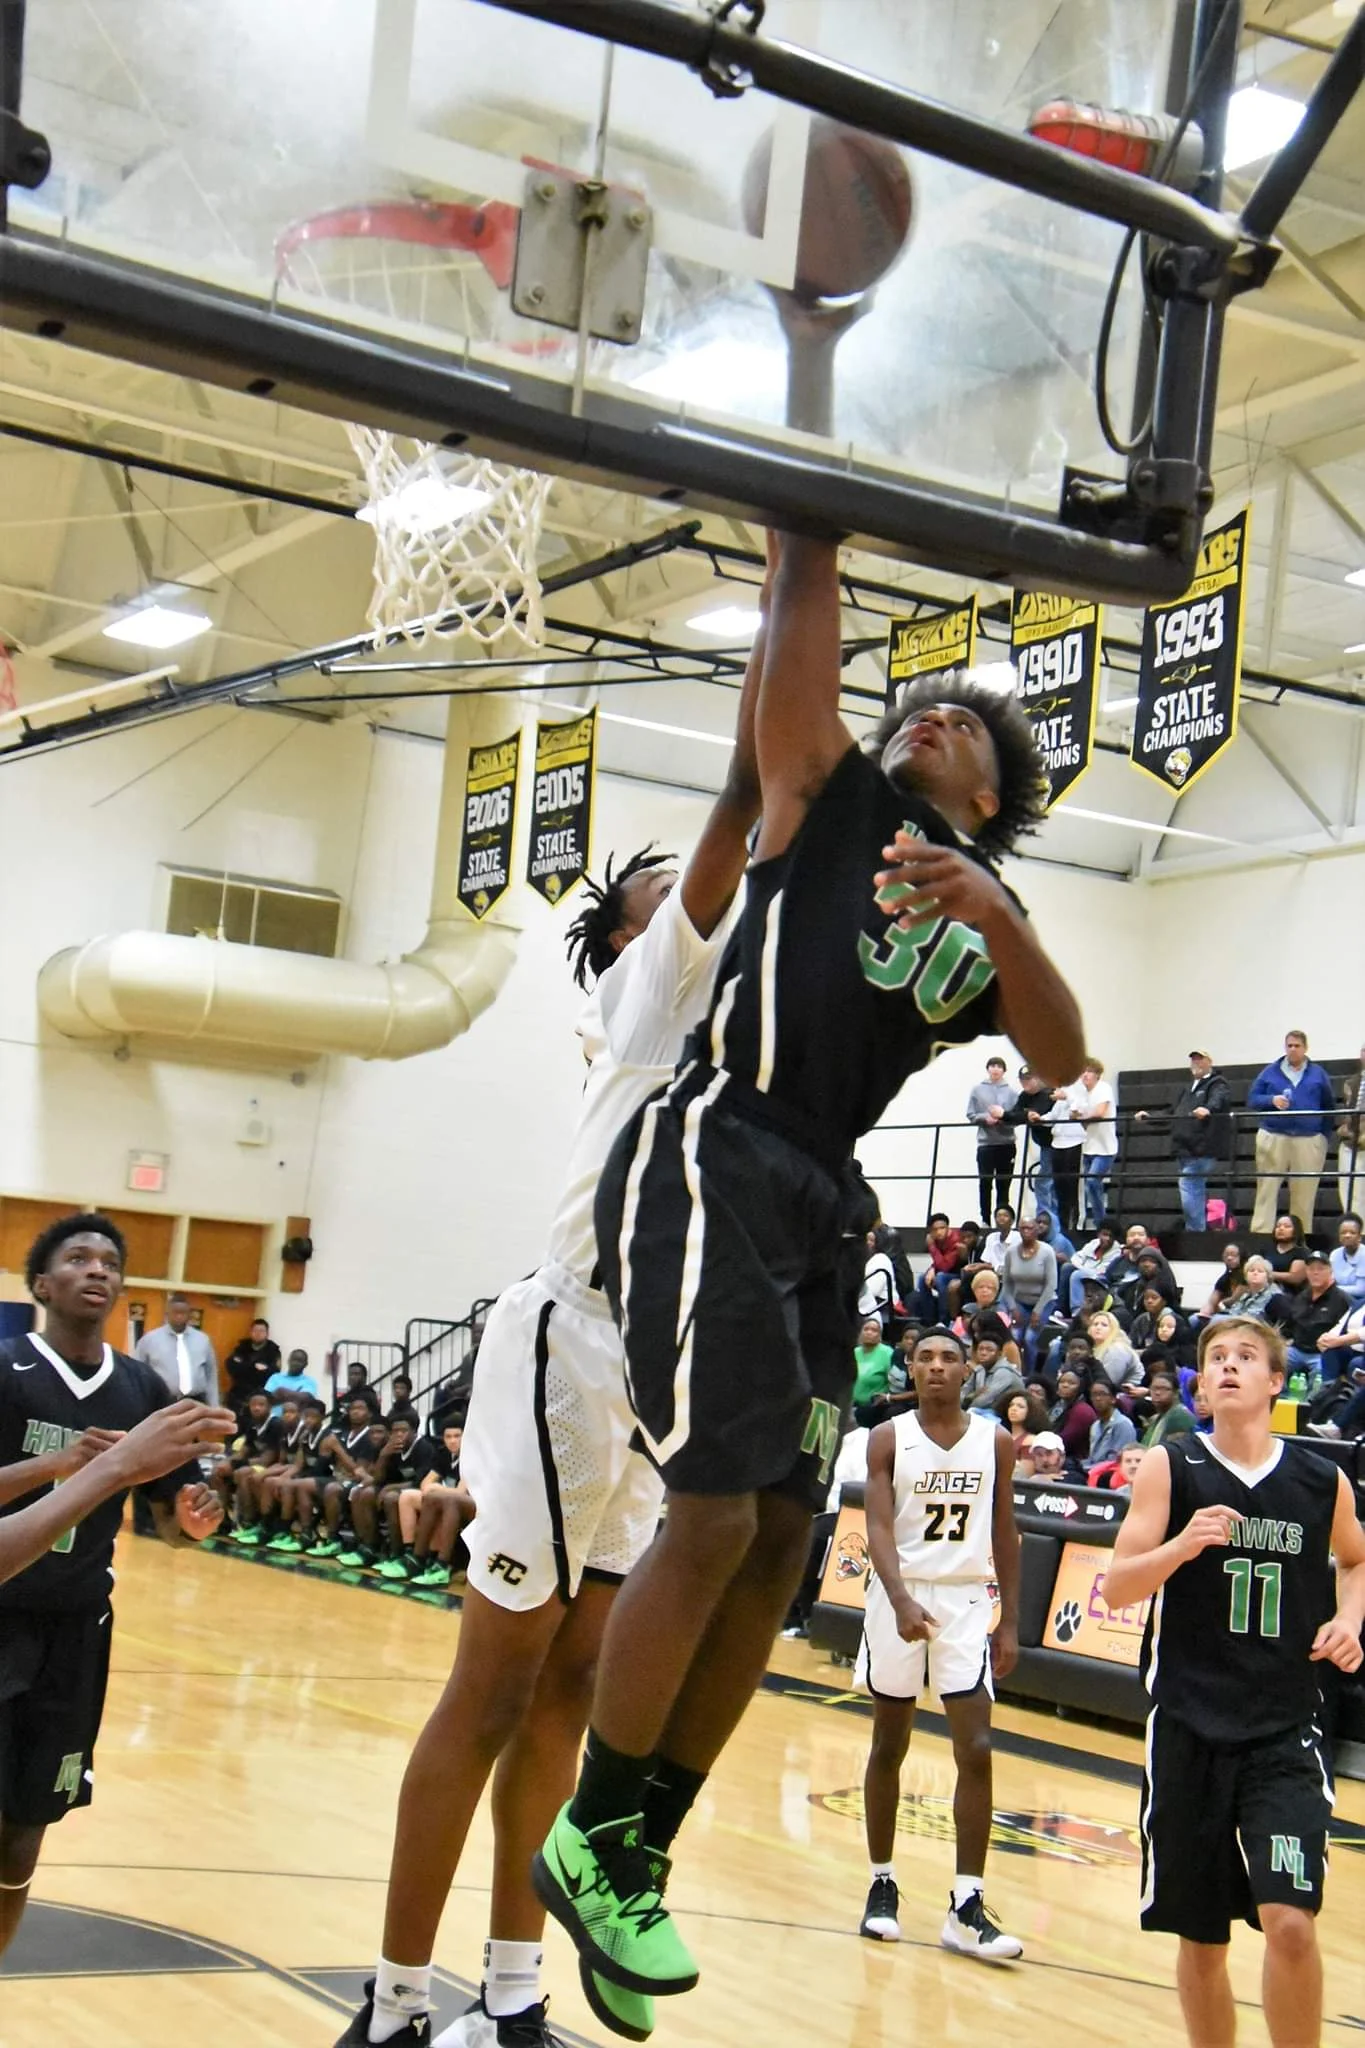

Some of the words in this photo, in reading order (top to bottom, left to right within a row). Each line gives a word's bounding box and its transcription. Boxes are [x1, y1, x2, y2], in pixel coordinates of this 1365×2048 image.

[1154, 595, 1225, 668] 1993
[1017, 632, 1083, 699] 1990
[1151, 682, 1217, 729] STATE
[1143, 713, 1224, 753] CHAMPIONS
[1041, 744, 1081, 771] PIONS
[535, 764, 586, 814] 2005
[467, 786, 512, 833] 2006
[468, 847, 502, 876] STATE
[537, 828, 576, 859] STATE
[461, 869, 506, 894] CHAMPIONS
[531, 851, 584, 877] CHAMPIONS
[857, 881, 998, 1024] 30
[913, 1471, 983, 1494] JAGS
[924, 1503, 970, 1541] 23
[1224, 1516, 1304, 1555] AWKS
[1224, 1558, 1282, 1638] 11
[1270, 1834, 1312, 1891] NL
